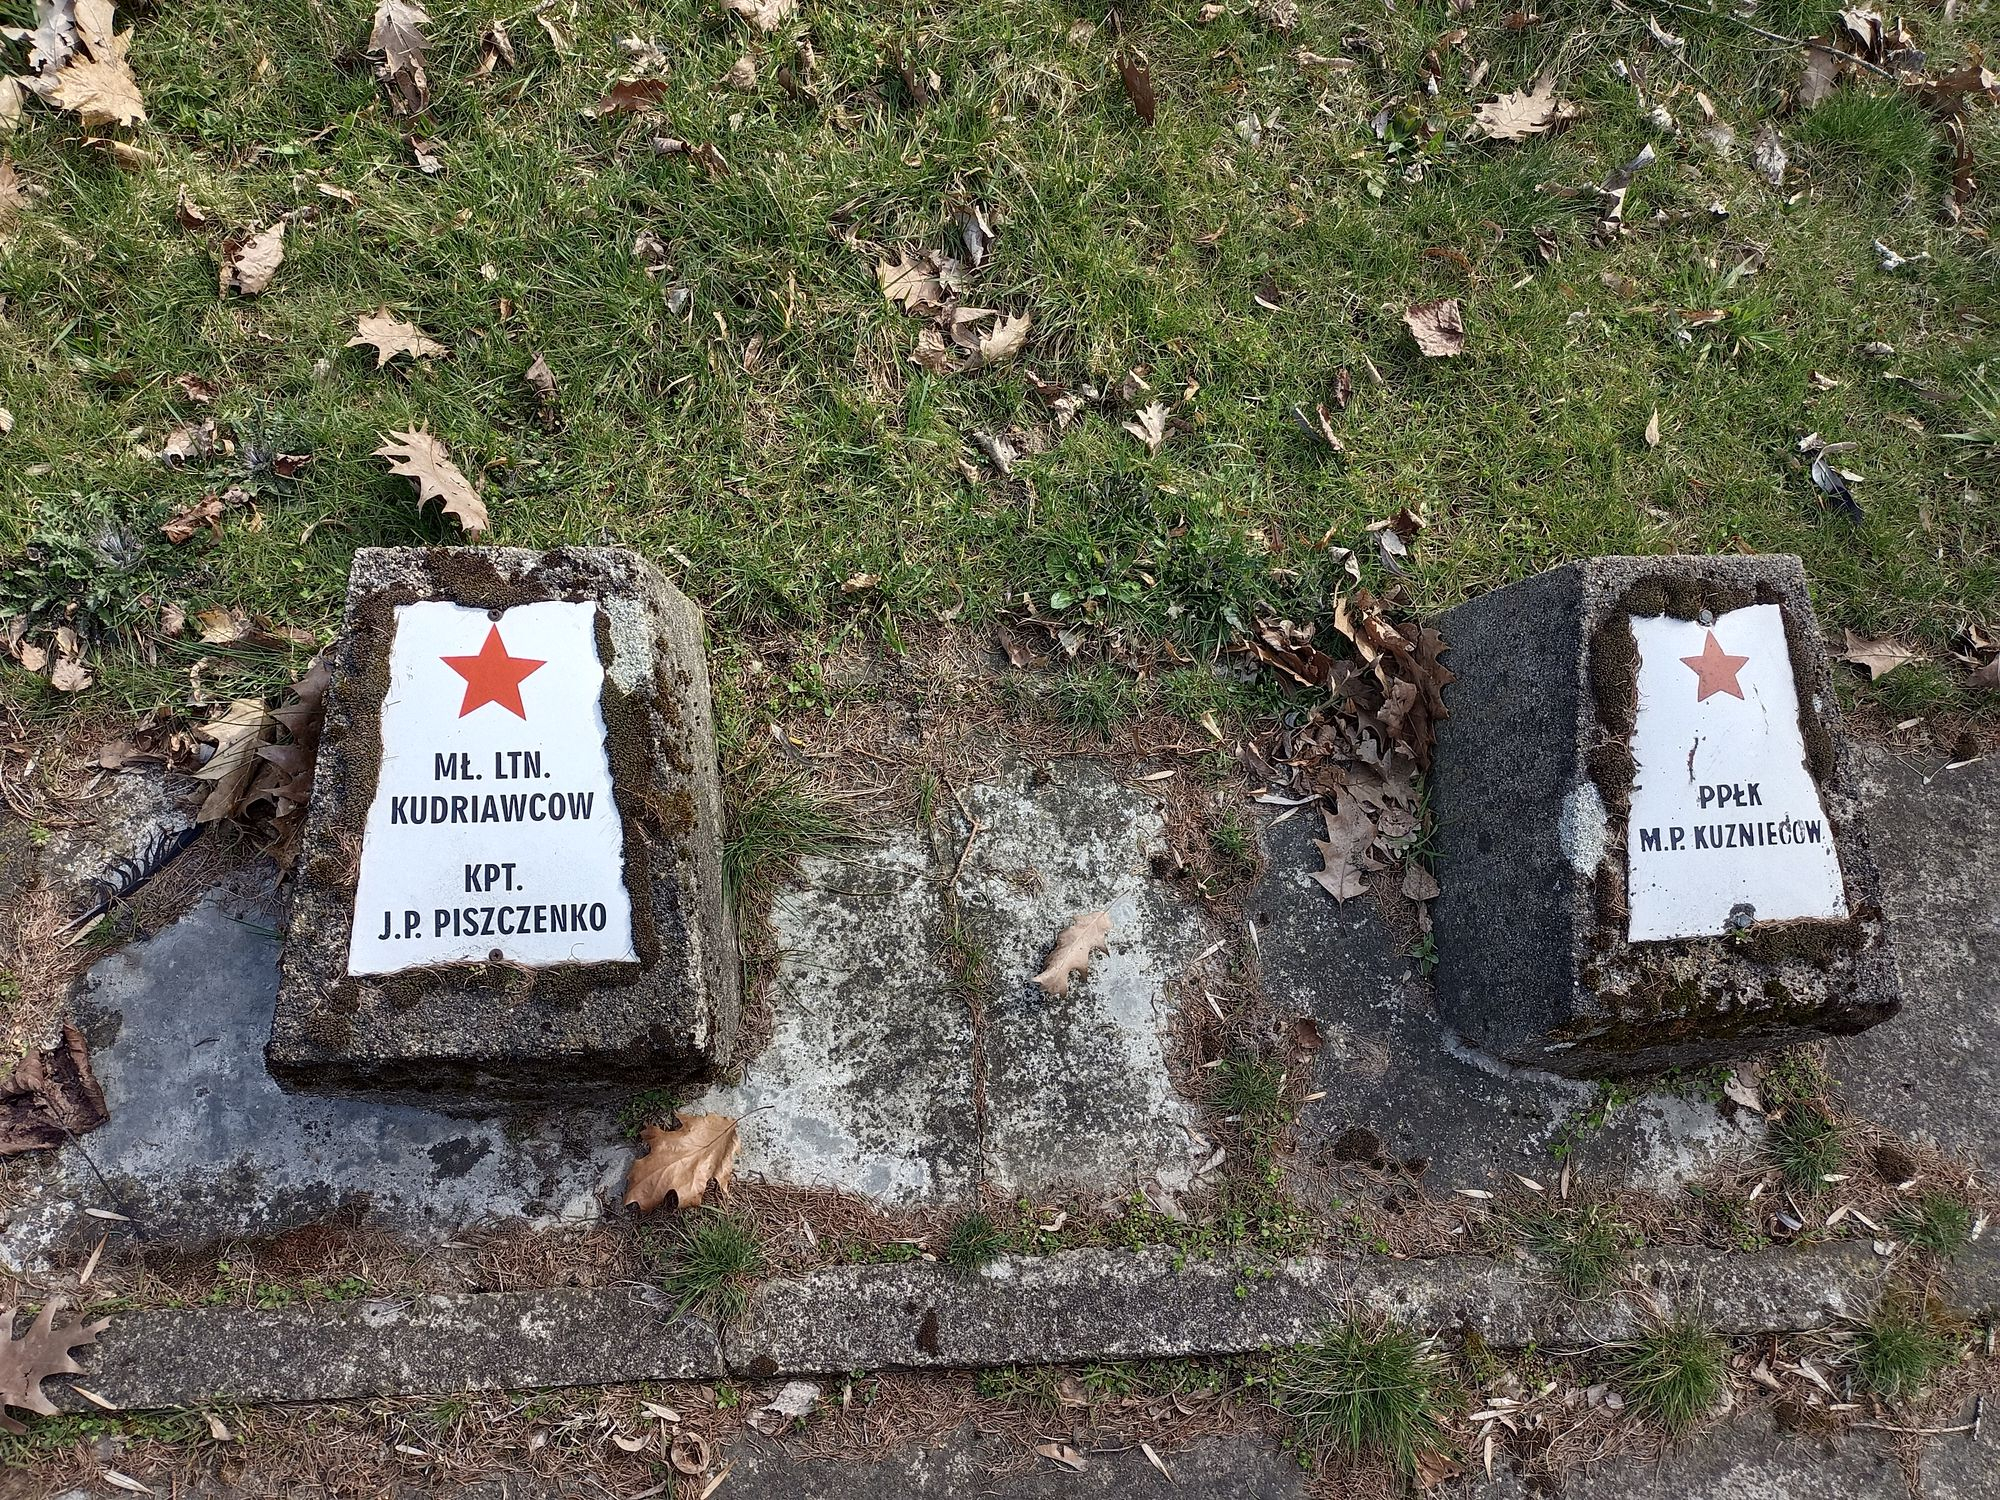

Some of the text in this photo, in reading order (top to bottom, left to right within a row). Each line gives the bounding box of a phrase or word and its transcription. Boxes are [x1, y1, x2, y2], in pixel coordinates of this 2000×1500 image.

[434, 750, 551, 781] MŁ. LTN.
[391, 791, 595, 825] KUDRIAWCOW
[1699, 782, 1763, 809] PPŁK
[1639, 826, 1686, 852] M.P.
[464, 862, 523, 893] KPT.
[377, 902, 607, 941] J.P. PISZCZENKO
